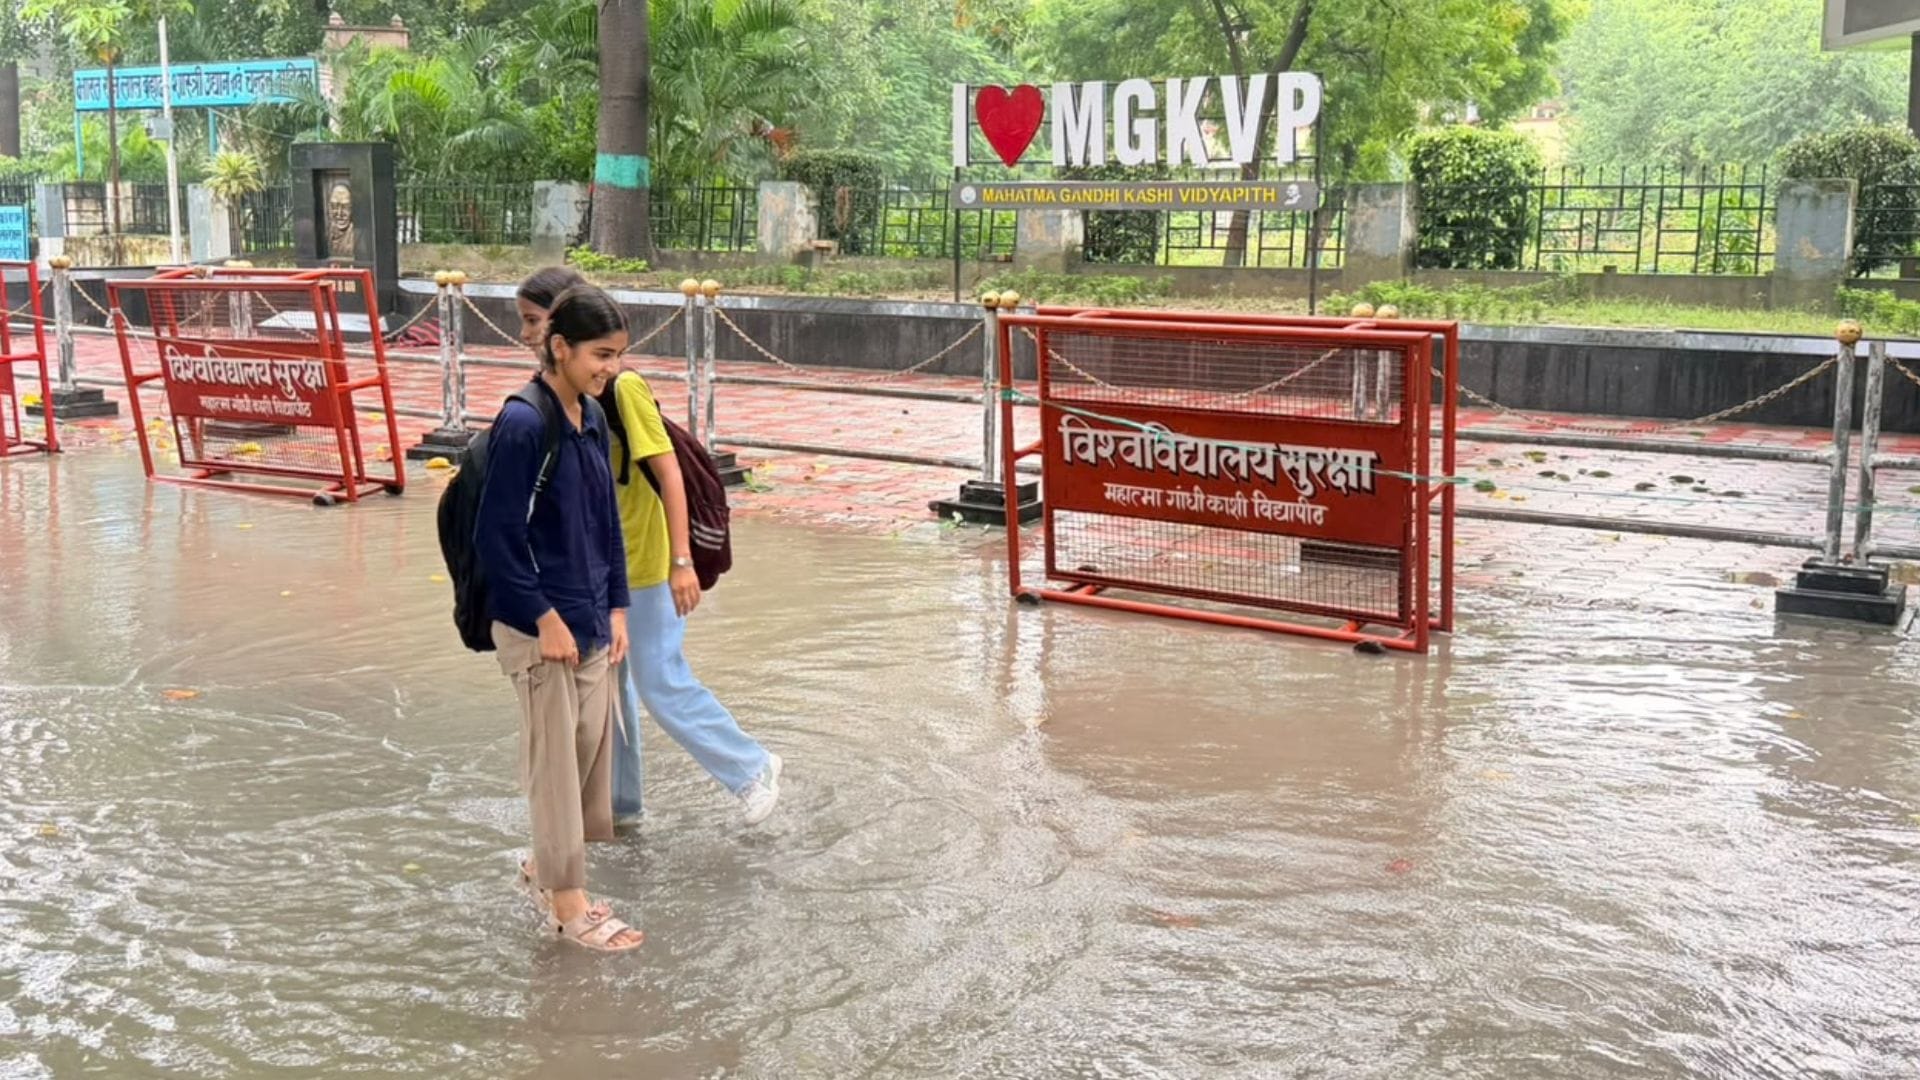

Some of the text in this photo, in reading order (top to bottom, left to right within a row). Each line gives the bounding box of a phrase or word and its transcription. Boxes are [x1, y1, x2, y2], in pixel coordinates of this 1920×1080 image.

[952, 71, 1322, 167] I MGKVP
[982, 186, 1277, 204] MAHATMA GANDHI KASHI VIDYAPITH
[164, 344, 328, 400] विश्वविद्यालय सुरक्षा
[1058, 414, 1380, 497] विश्वविद्यालय सुरक्षा
[1103, 482, 1328, 526] महात्मा गांधी काशी विद्यापीठ
